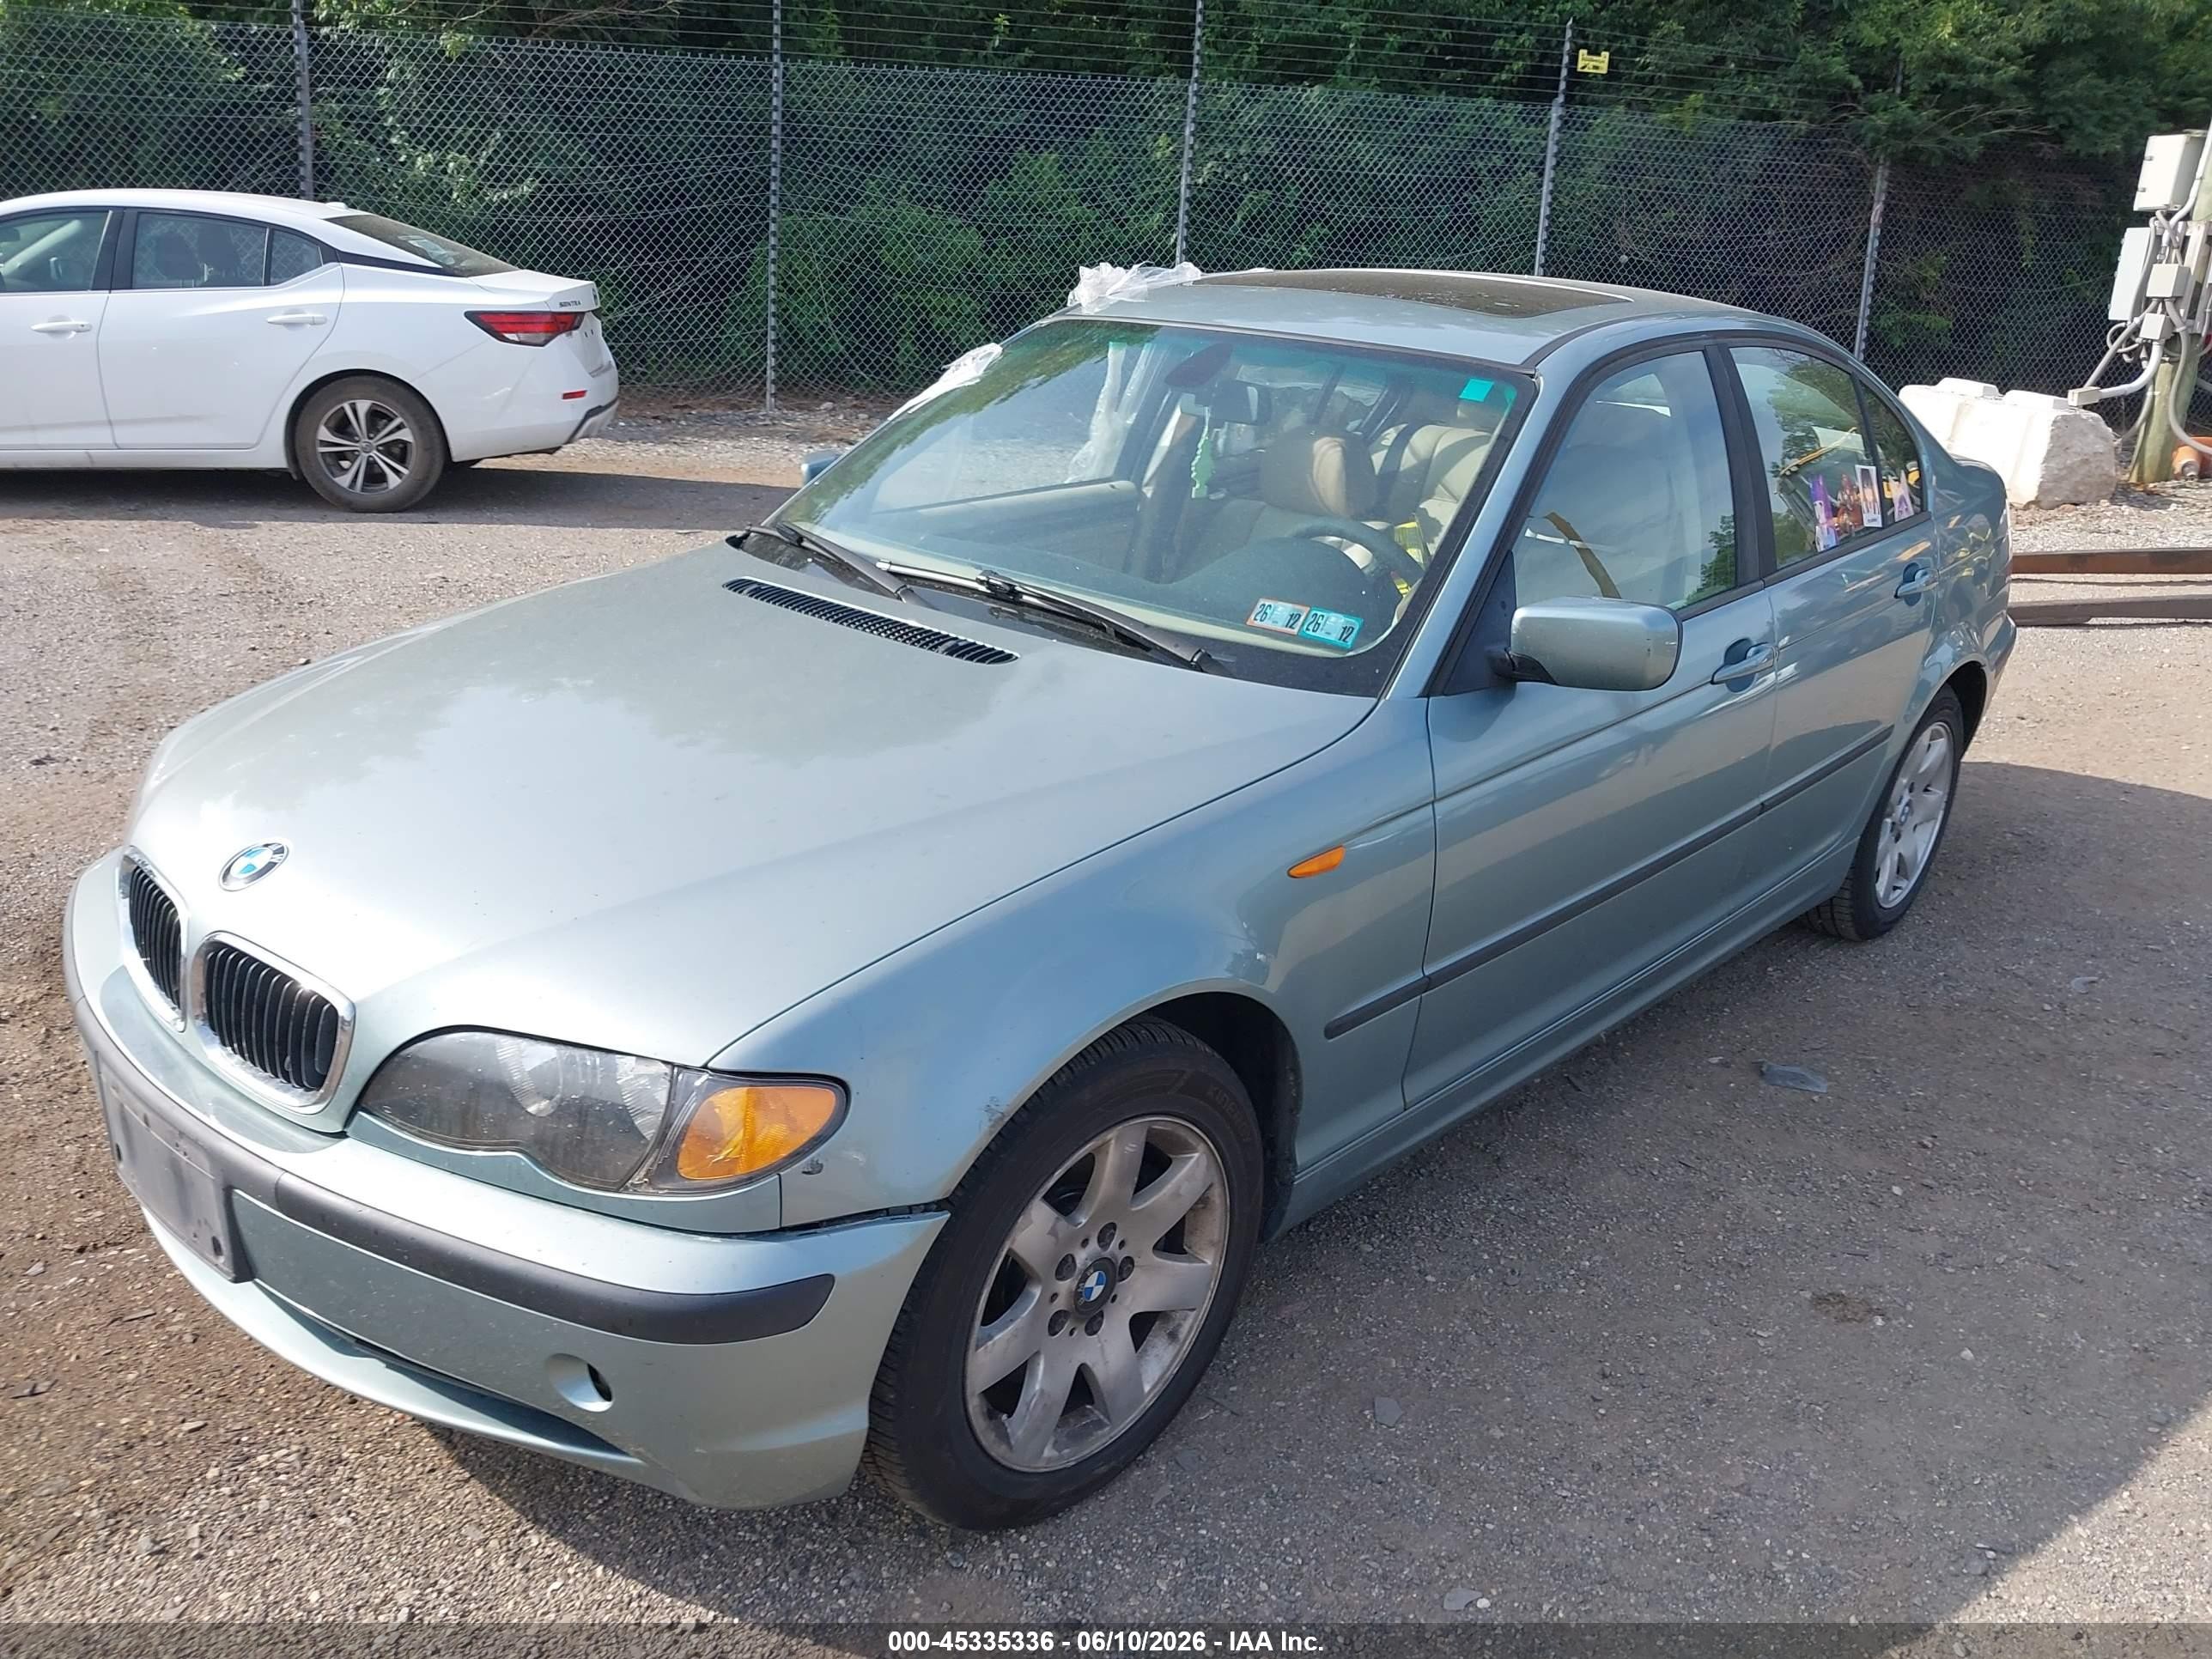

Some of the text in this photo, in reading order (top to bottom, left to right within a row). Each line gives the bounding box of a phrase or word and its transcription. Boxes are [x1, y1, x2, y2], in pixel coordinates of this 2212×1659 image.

[1254, 604, 1302, 629] 26 12
[1305, 612, 1355, 643] 26 12
